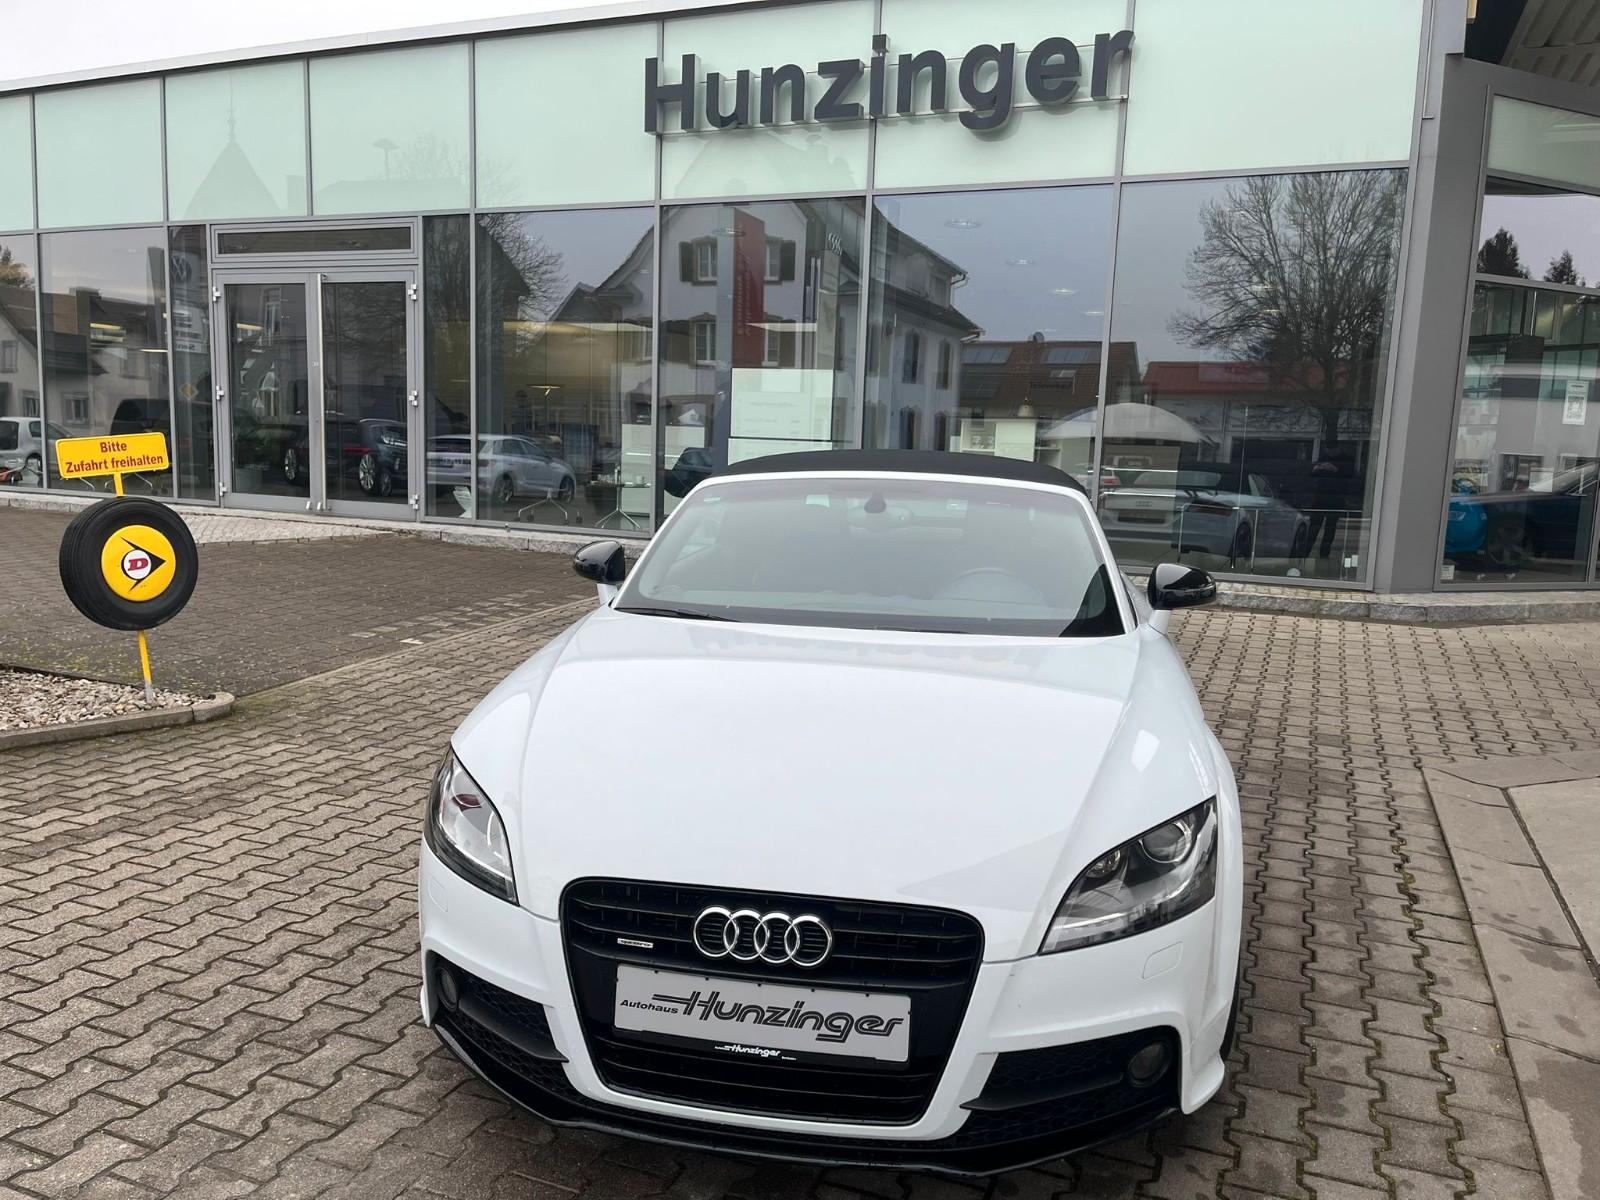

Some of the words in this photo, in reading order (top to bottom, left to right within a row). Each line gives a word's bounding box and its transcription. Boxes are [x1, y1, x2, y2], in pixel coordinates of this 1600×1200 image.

[644, 29, 1135, 136] Hunzinger
[100, 441, 128, 453] Bitte
[65, 458, 108, 474] Zufahrt
[111, 454, 164, 469] freihalten
[127, 557, 149, 572] D
[620, 999, 679, 1015] Autohaus
[651, 990, 904, 1043] Hunzinger
[724, 1044, 781, 1058] Hunzinger
